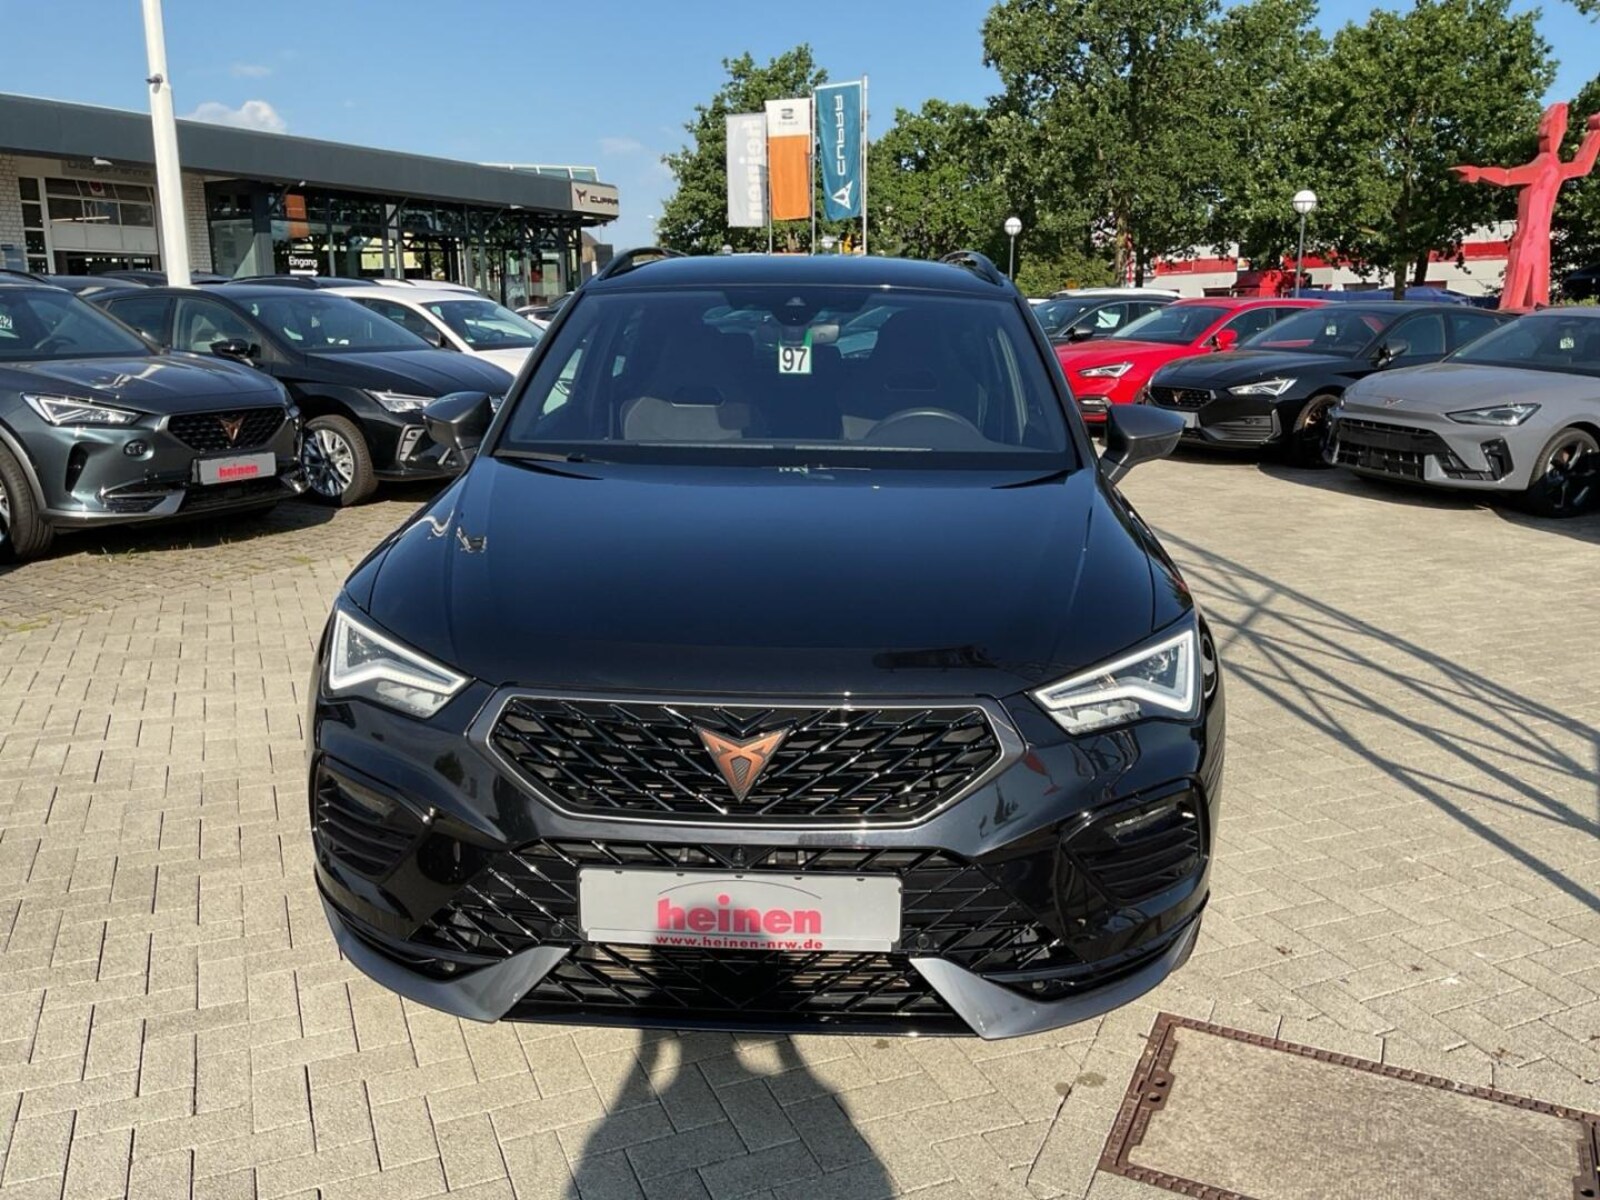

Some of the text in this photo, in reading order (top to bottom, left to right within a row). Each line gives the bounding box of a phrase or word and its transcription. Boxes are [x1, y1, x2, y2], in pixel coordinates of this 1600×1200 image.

[288, 255, 318, 269] Eingang
[782, 347, 808, 371] 97
[218, 464, 258, 478] heinen
[657, 894, 822, 934] heinen
[656, 936, 823, 949] www.heinen-nrw.de
